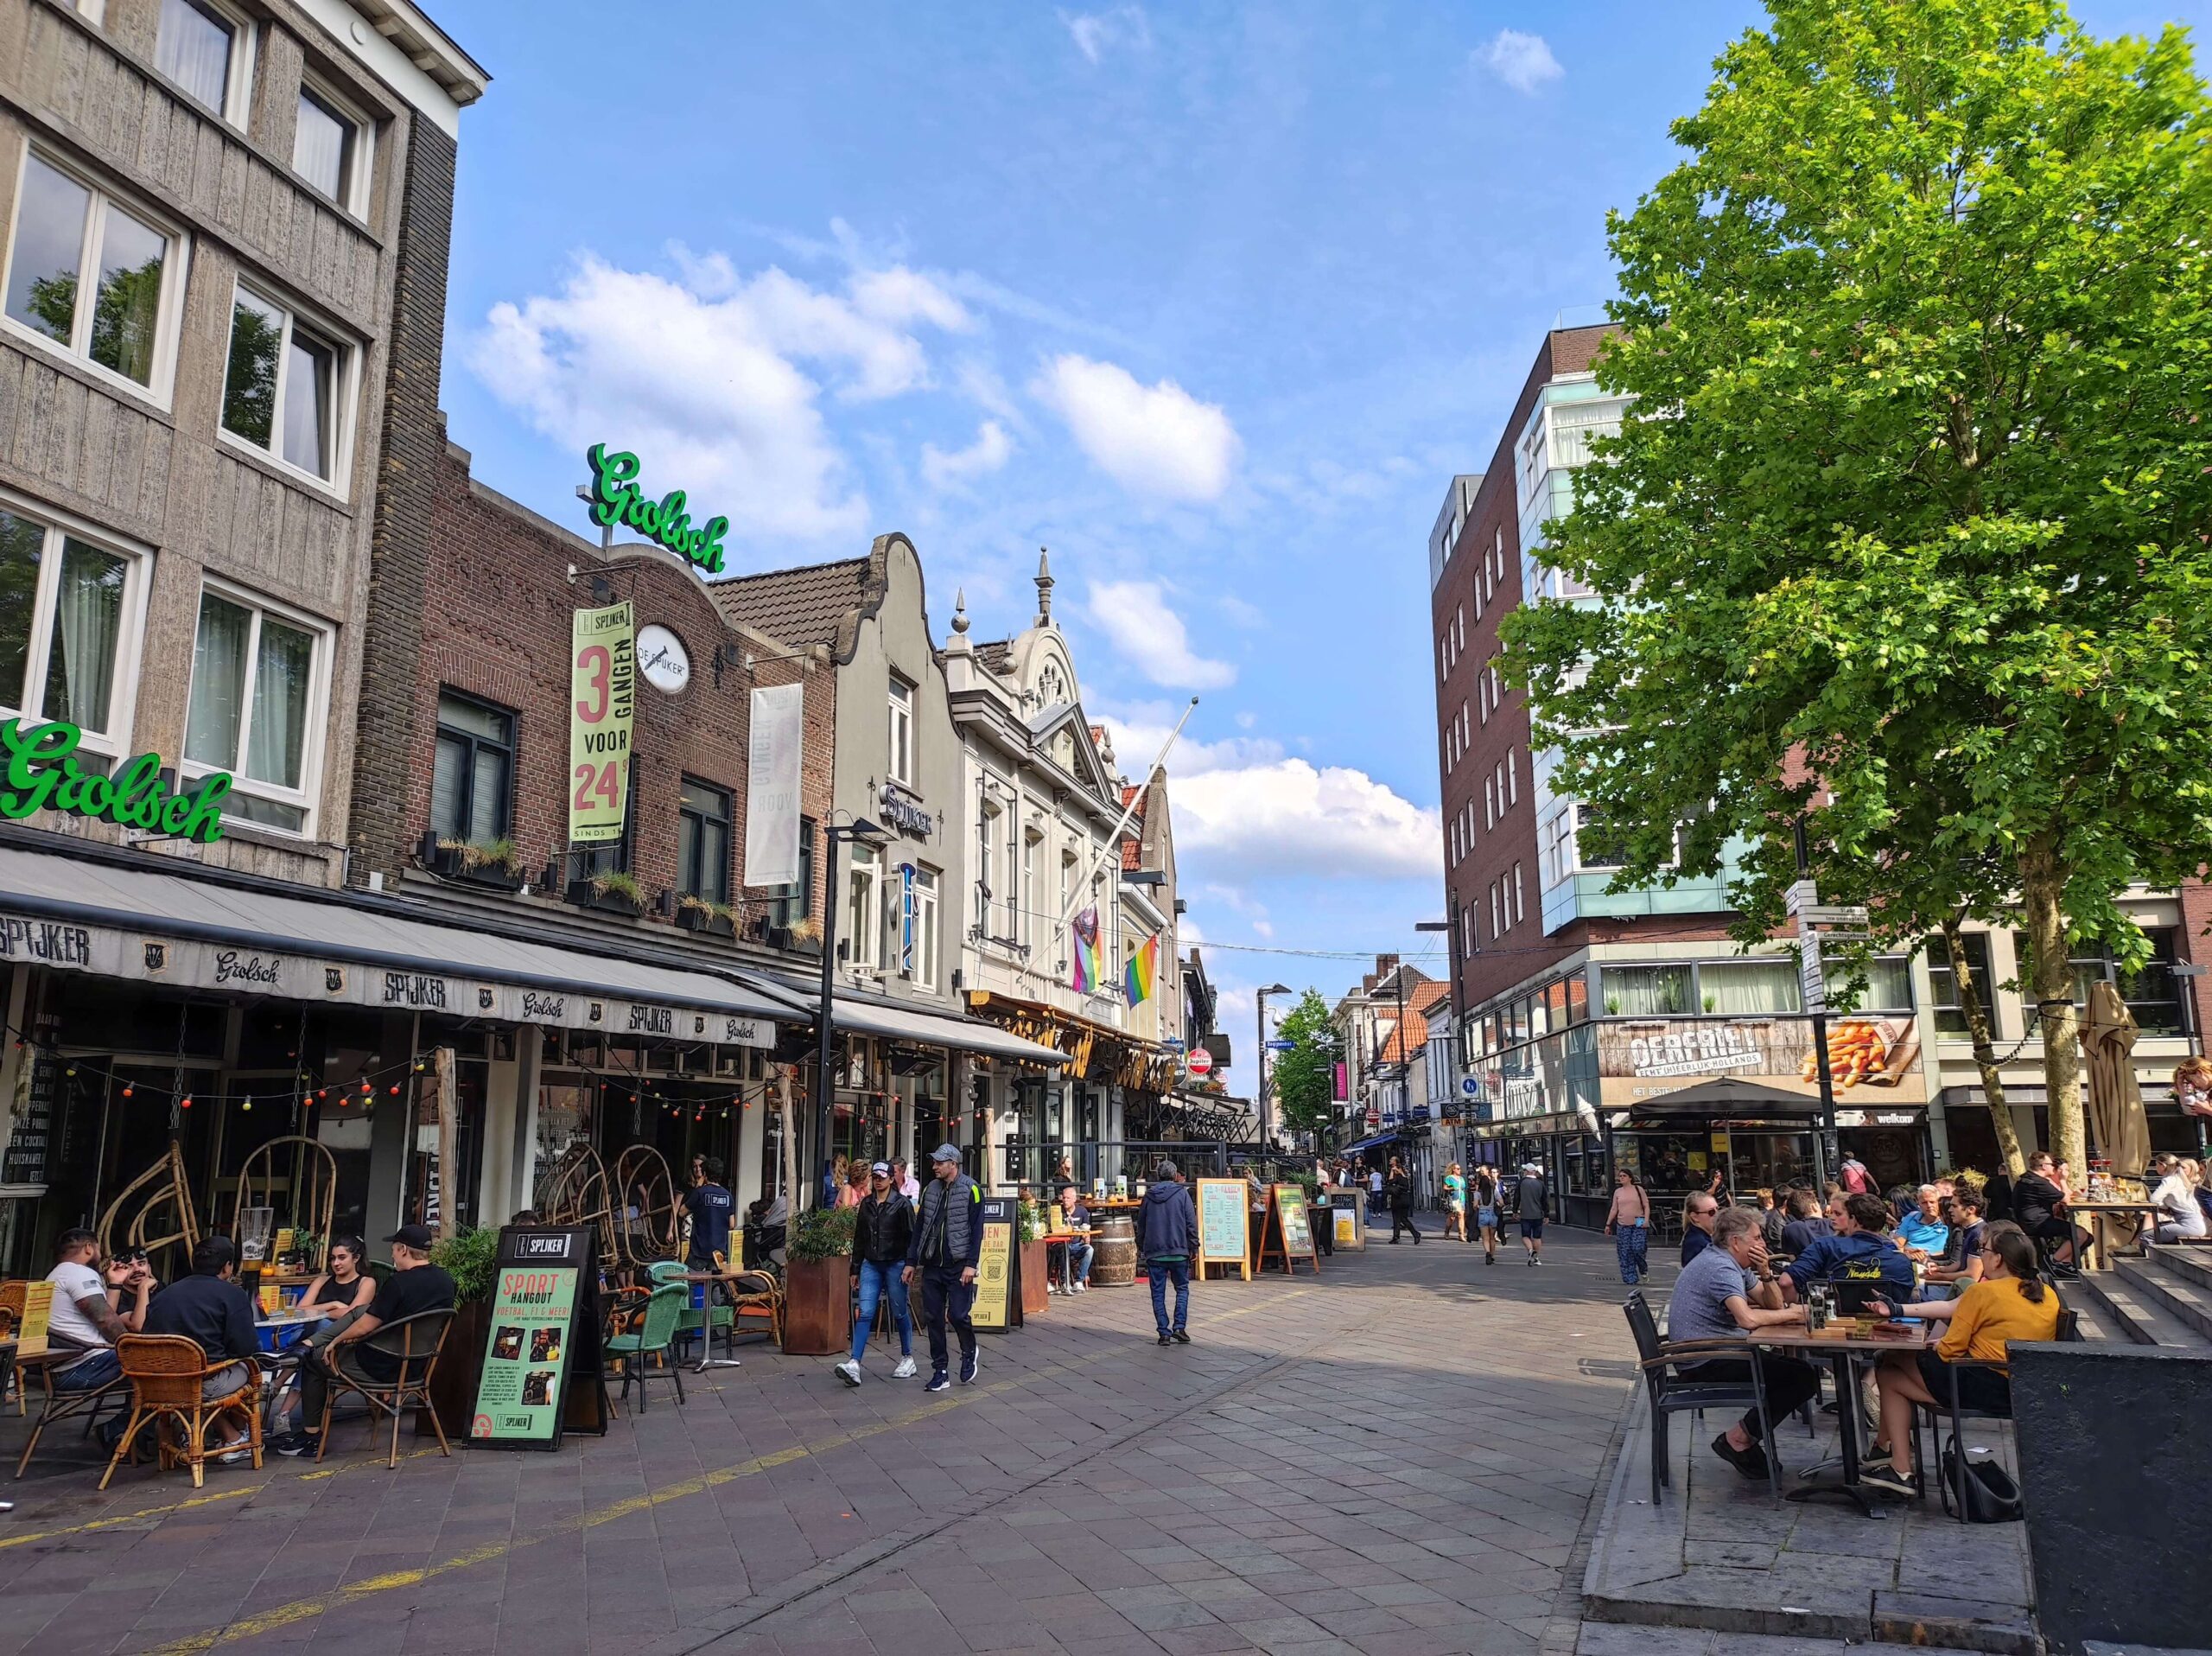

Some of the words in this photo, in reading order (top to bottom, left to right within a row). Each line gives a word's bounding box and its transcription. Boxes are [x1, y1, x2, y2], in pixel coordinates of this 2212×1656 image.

[588, 443, 729, 573] Grolsch
[595, 610, 626, 630] SPIJKER
[638, 647, 649, 662] DE
[576, 645, 610, 723] 3
[613, 638, 632, 719] GANGEN
[584, 729, 627, 755] VOOR
[0, 718, 232, 843] Grolsch
[216, 952, 281, 984] Grolsch
[385, 972, 446, 1008] SPIJKER
[523, 992, 564, 1018] Grolsch
[629, 1004, 672, 1034] SPIJKER
[726, 1018, 755, 1040] Grolsch
[1712, 1054, 1758, 1068] HOLLANDS
[1632, 1087, 1646, 1096] HET
[1877, 1113, 1914, 1124] welkom
[530, 1239, 563, 1252] SPIJKER
[503, 1273, 560, 1296] SPORT
[510, 1292, 553, 1304] HANGOUT
[496, 1306, 528, 1316] VOETBAL,
[548, 1306, 569, 1317] MEER!
[505, 1417, 528, 1428] SPIJKER
